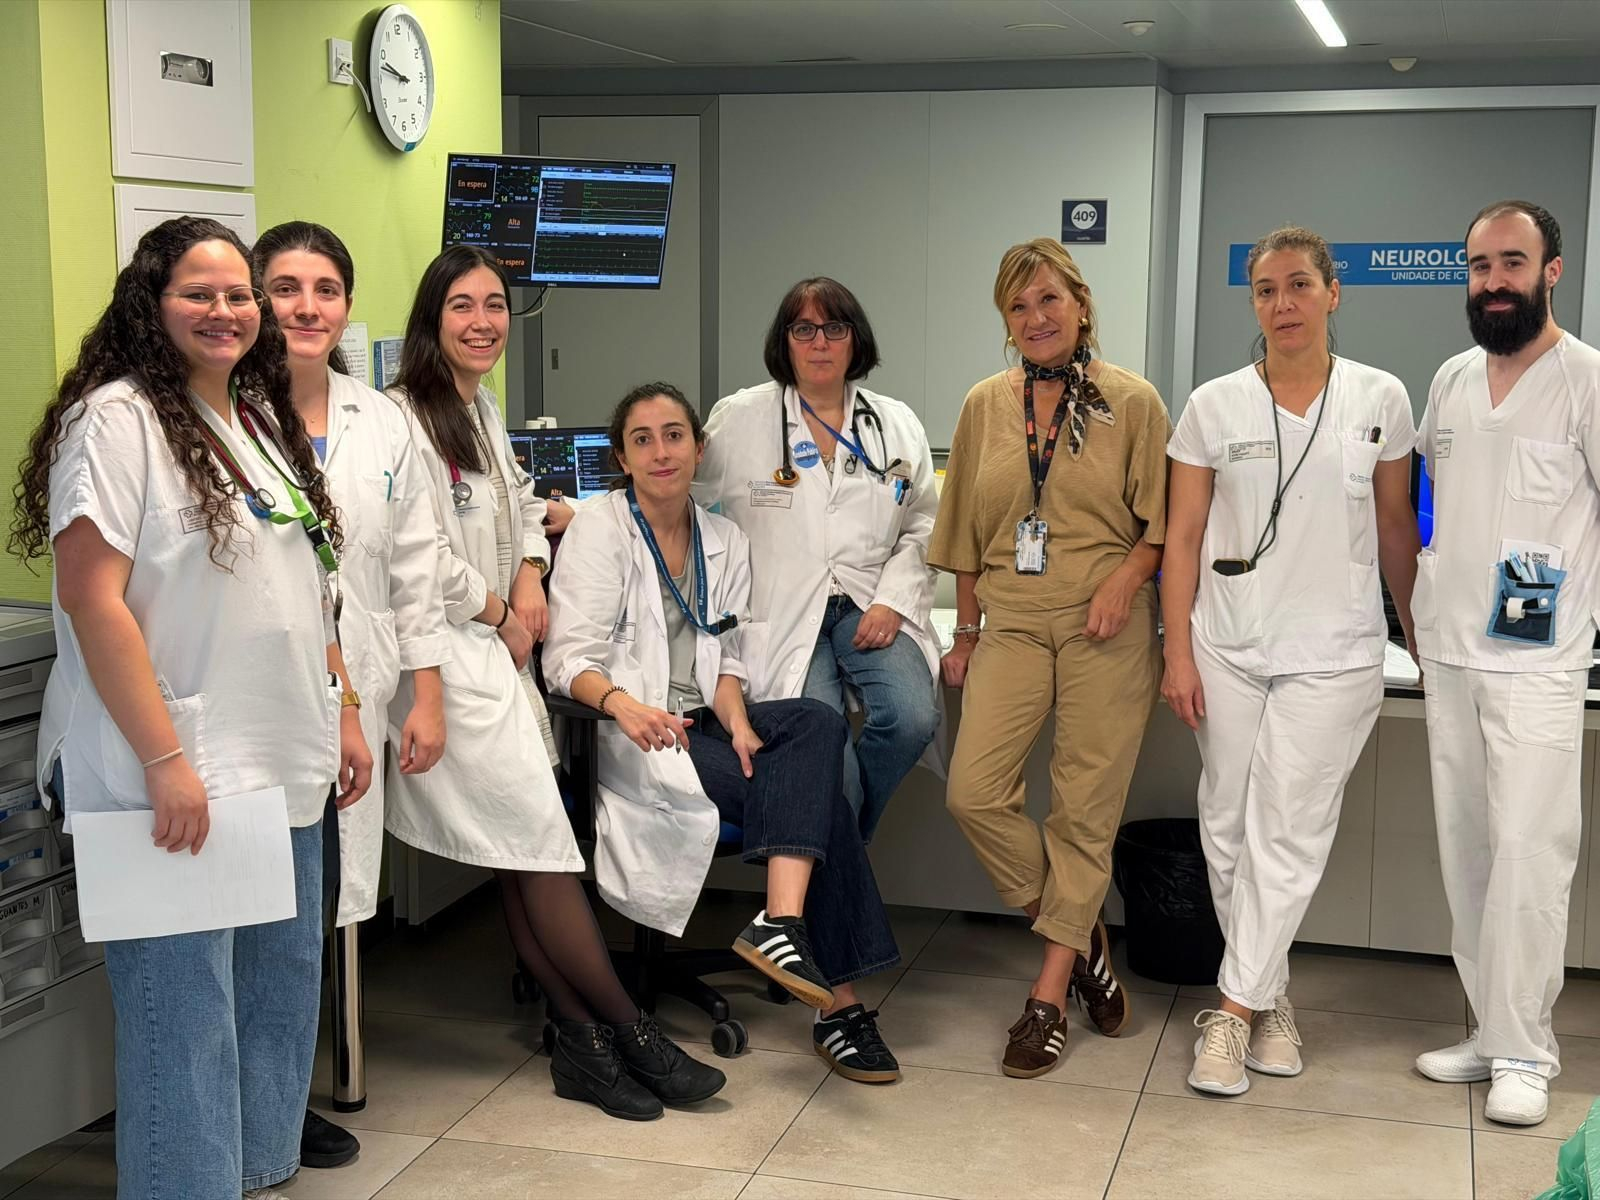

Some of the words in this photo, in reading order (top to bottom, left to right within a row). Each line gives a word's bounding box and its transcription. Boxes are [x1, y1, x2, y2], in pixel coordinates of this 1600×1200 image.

[394, 24, 401, 35] 12
[414, 48, 419, 59] 2
[419, 72, 423, 82] 3
[417, 95, 422, 105] 4
[392, 115, 397, 126] 7
[411, 113, 415, 124] 5
[402, 121, 406, 131] 6
[467, 180, 487, 189] espera
[1073, 211, 1096, 222] 409
[507, 218, 520, 226] Alta
[1371, 249, 1467, 266] NEUROLO
[505, 259, 525, 267] espera
[1391, 271, 1436, 280] UNIDADE
[1438, 271, 1451, 280] DE
[1453, 271, 1468, 280] ICT
[551, 488, 562, 496] Alta
